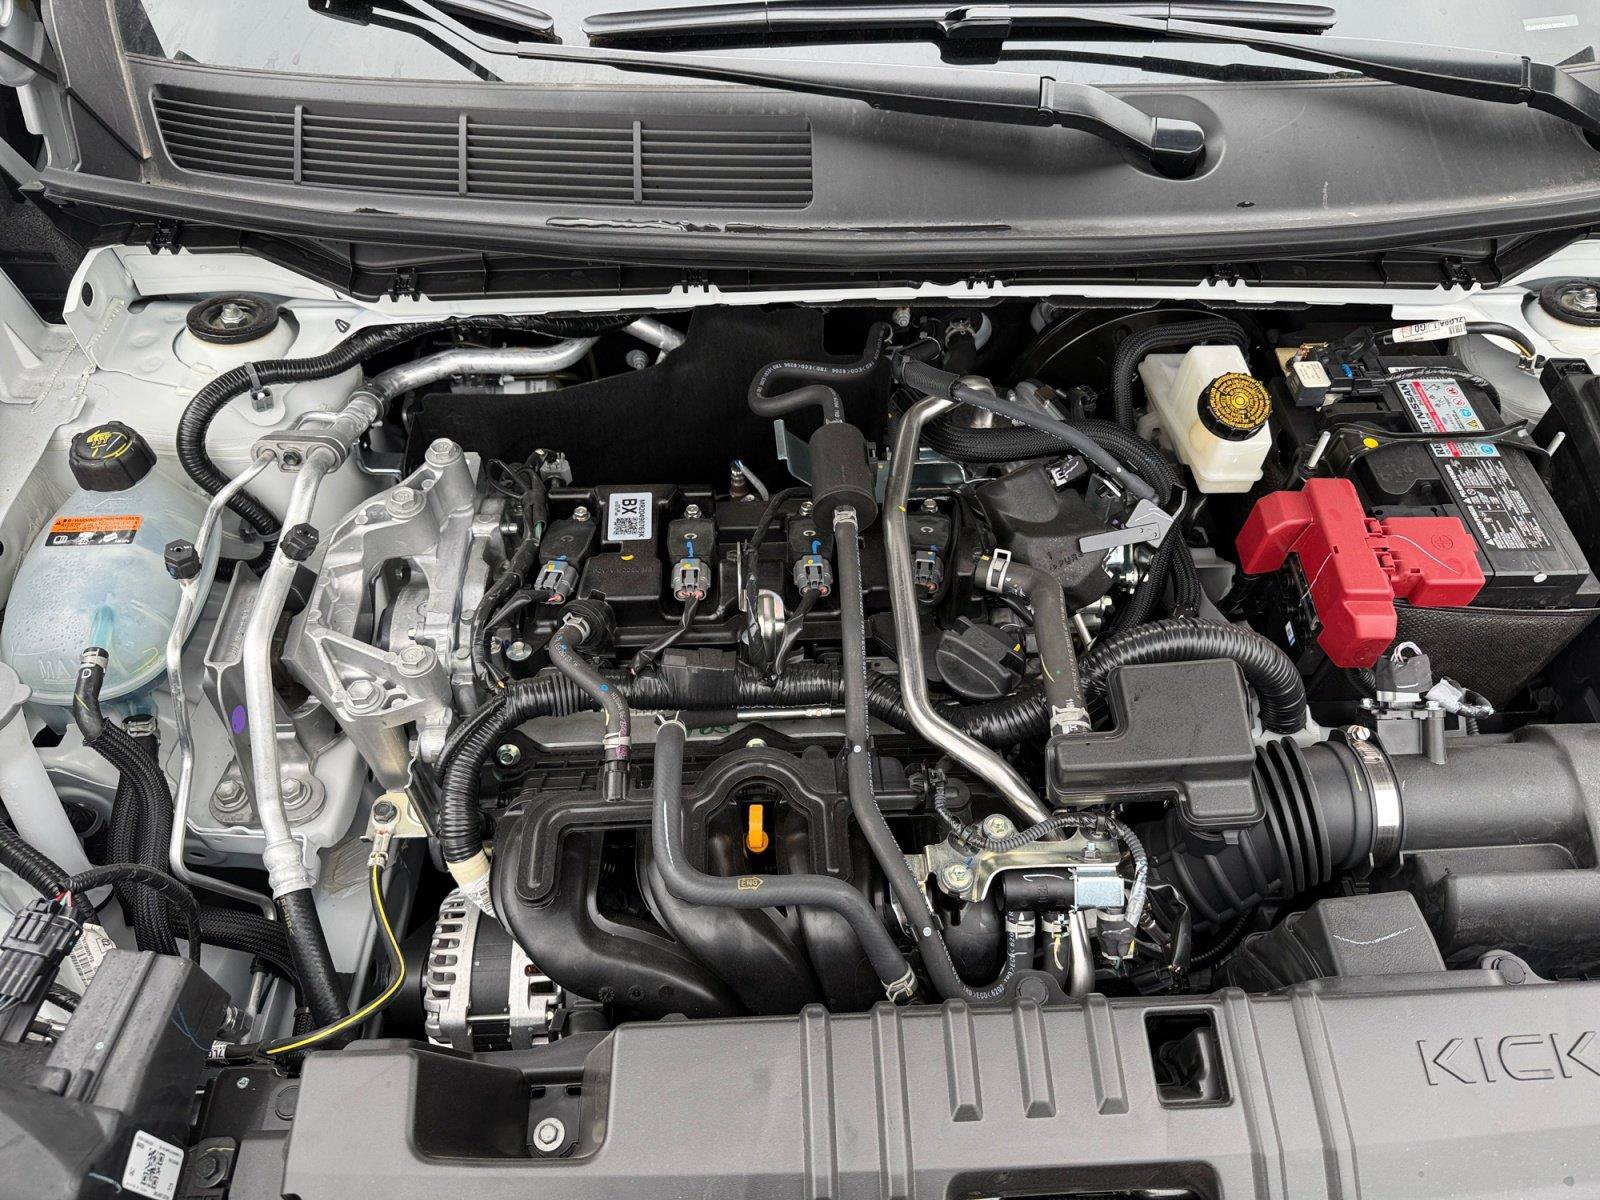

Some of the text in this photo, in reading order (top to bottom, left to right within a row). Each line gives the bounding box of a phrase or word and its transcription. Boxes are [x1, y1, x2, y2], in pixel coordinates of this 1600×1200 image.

[1398, 381, 1426, 419] NISSAN
[621, 498, 638, 515] BX
[81, 667, 92, 679] D
[740, 878, 759, 888] ENG
[1416, 1030, 1600, 1086] KICK
